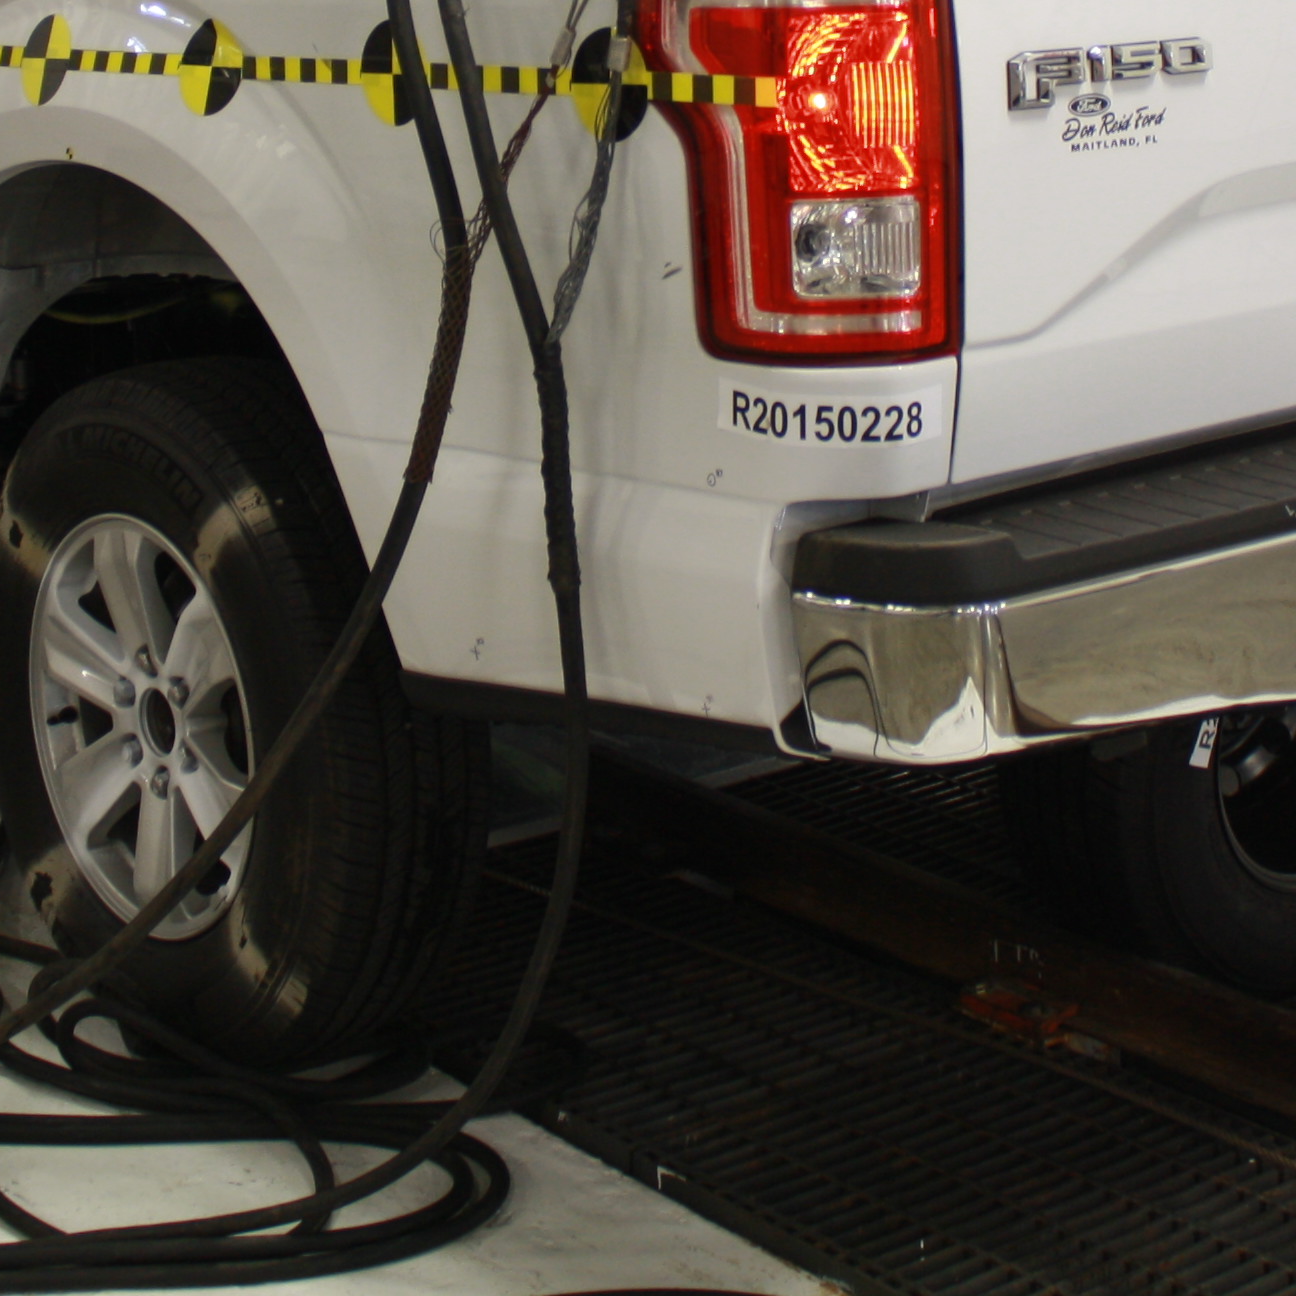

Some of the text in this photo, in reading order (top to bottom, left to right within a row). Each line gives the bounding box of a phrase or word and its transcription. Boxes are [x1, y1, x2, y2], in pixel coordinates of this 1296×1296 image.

[1007, 36, 1214, 111] F150
[1062, 106, 1166, 142] Don Reid Ford
[1071, 135, 1158, 152] MAITLAND, FL
[731, 390, 924, 442] R20150228
